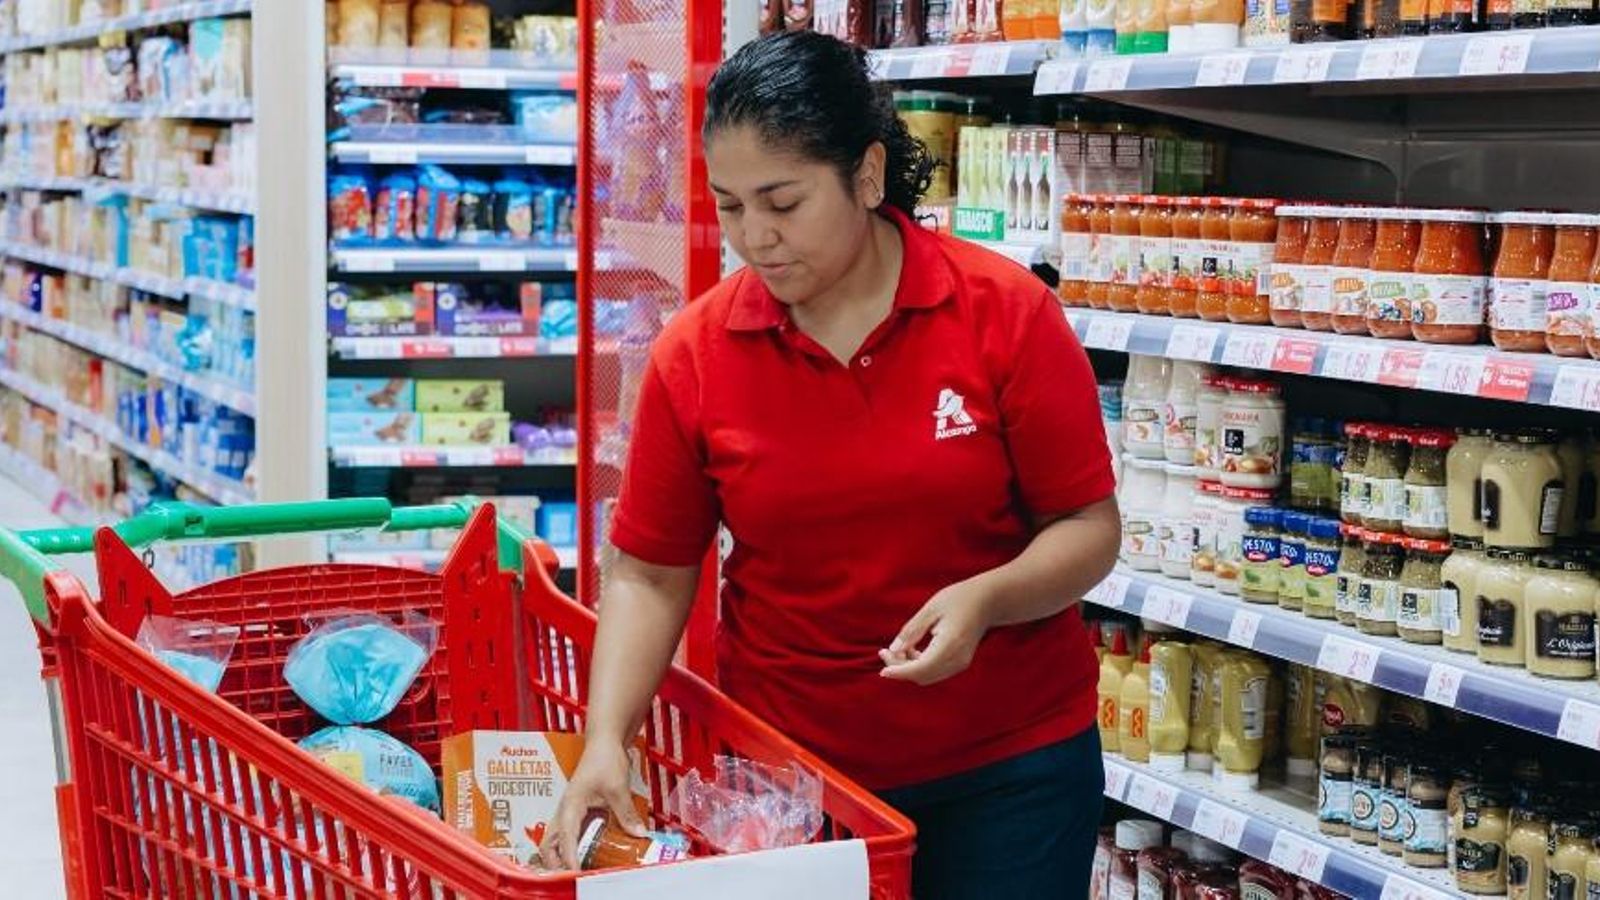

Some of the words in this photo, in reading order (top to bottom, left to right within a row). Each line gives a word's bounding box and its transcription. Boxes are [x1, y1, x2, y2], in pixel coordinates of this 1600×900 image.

[500, 745, 539, 757] Auchan
[487, 760, 552, 777] GALLETAS
[487, 781, 553, 797] DIGESTIVE
